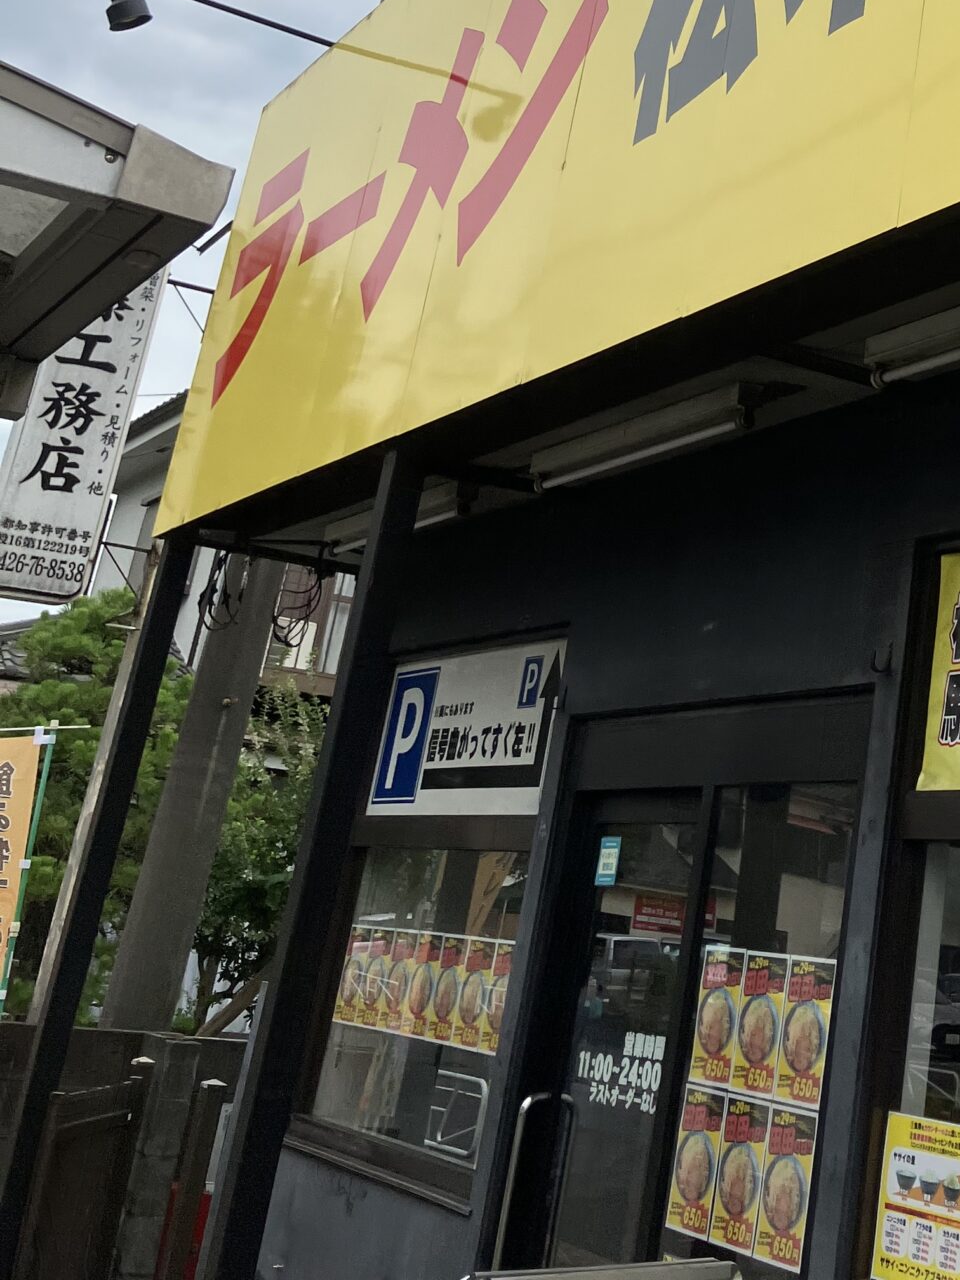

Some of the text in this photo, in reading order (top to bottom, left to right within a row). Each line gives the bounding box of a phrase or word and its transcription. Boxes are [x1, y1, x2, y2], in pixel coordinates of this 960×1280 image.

[384, 687, 425, 789] P
[705, 1059, 729, 1080] 650円
[748, 1068, 773, 1089] 650円
[589, 1081, 657, 1115] ラストオーダーなし
[793, 1077, 818, 1099] 650円
[683, 1206, 707, 1231] 650円
[727, 1220, 751, 1245] 650円
[773, 1236, 798, 1261] 650円
